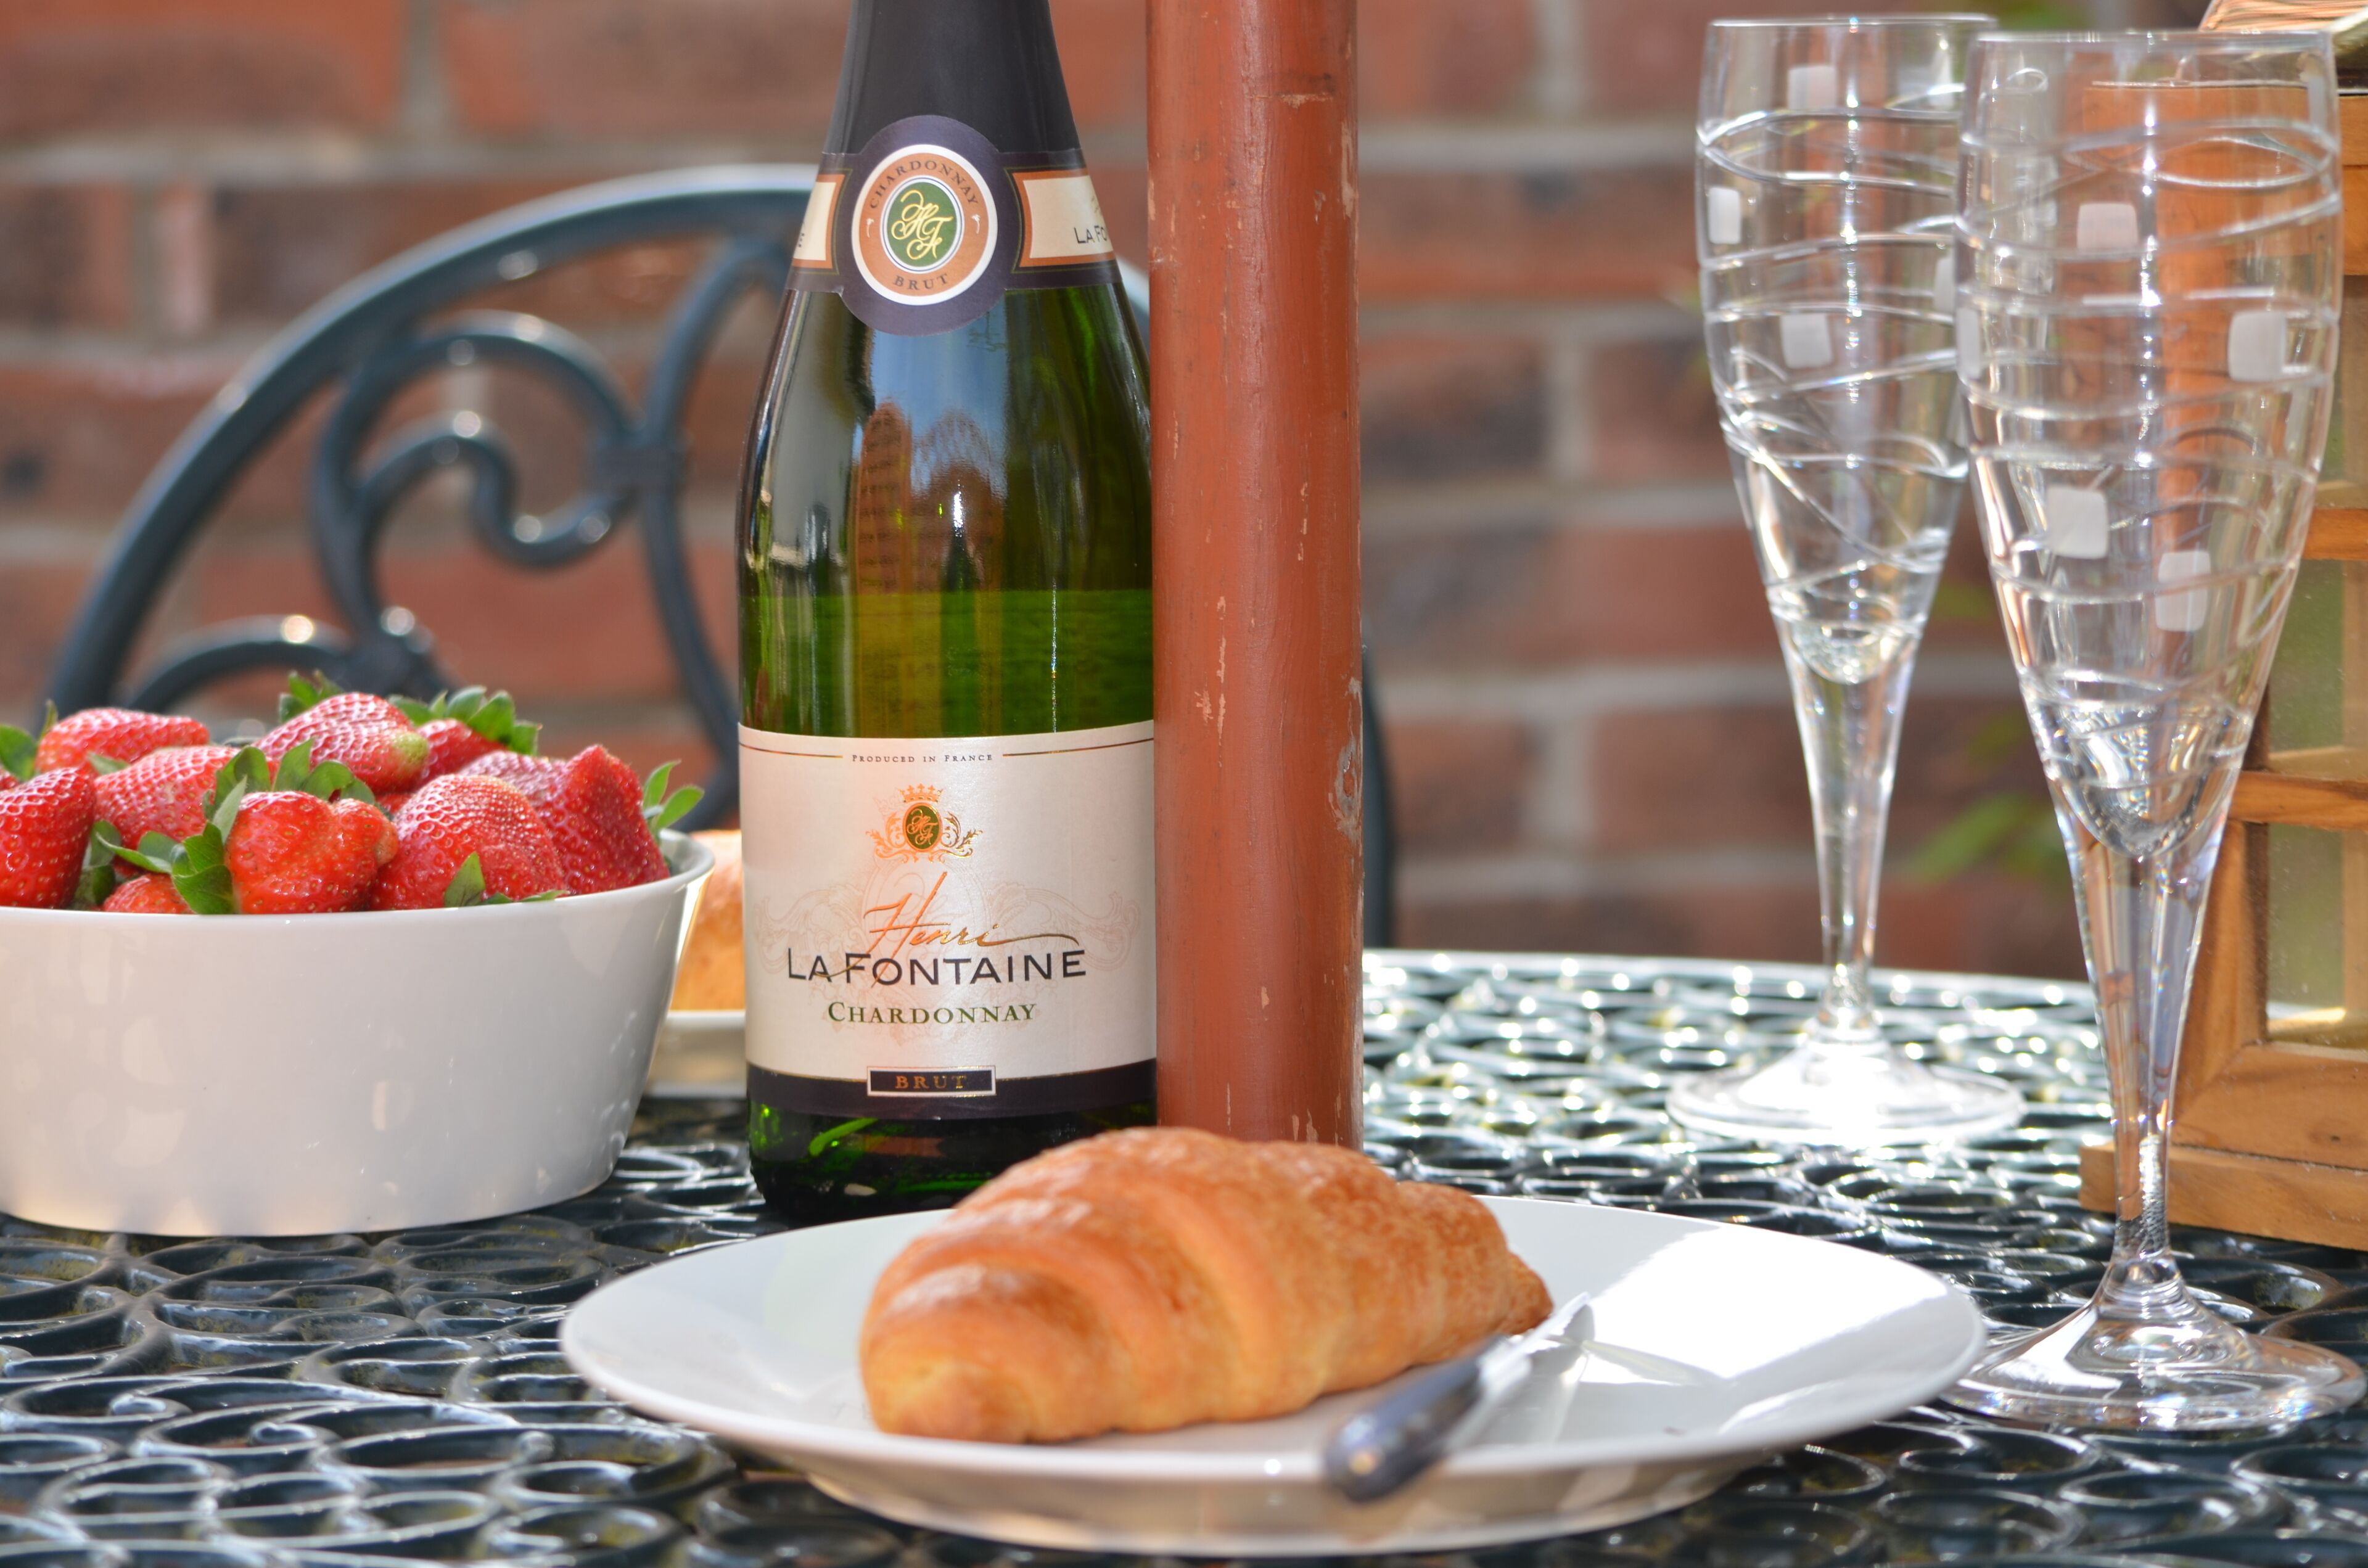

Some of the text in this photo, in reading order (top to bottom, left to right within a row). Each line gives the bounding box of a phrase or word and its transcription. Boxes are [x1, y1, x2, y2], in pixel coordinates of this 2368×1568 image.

[870, 159, 979, 210] CHARDONNAY
[1073, 226, 1095, 244] LA
[892, 273, 950, 291] BRUT
[852, 753, 993, 763] PRODUCED IN FRANCE
[814, 871, 1080, 988] Henri
[828, 1000, 1037, 1025] CHARDONNAY
[895, 1074, 968, 1090] BRUT
